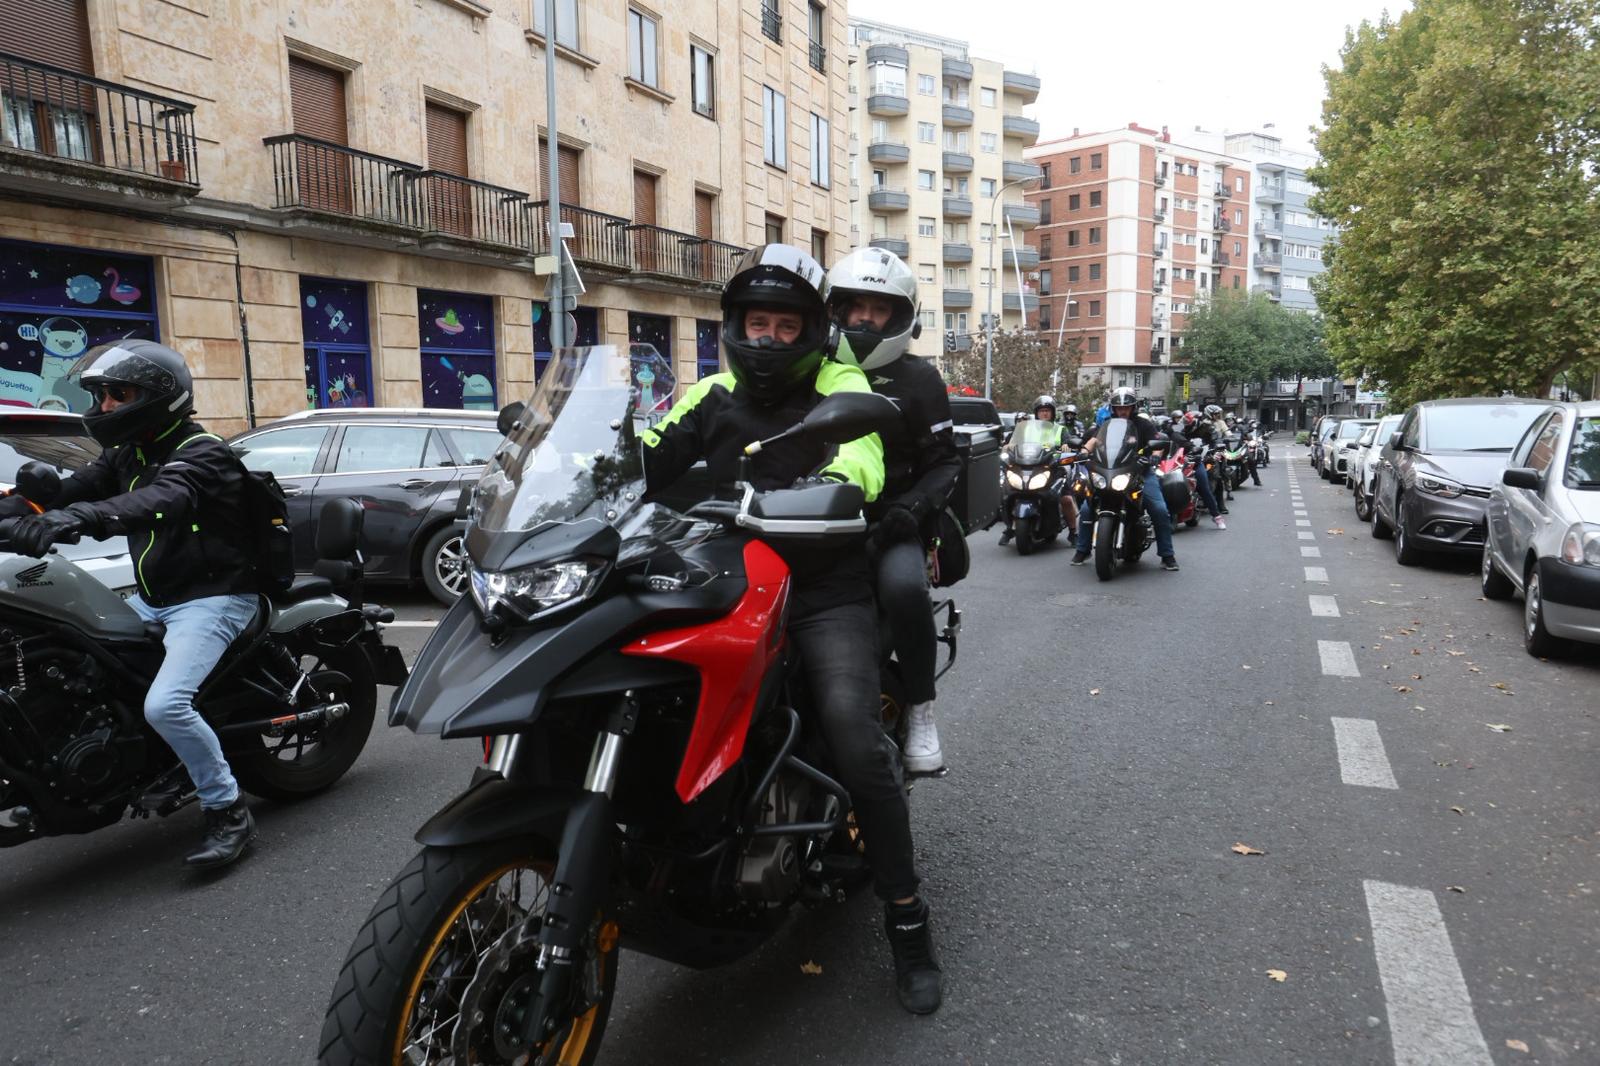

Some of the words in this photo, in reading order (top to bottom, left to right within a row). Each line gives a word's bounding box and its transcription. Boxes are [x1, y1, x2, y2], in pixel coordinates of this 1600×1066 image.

[20, 326, 36, 338] Hi!
[0, 379, 33, 393] uguettos
[16, 580, 54, 588] HONDA
